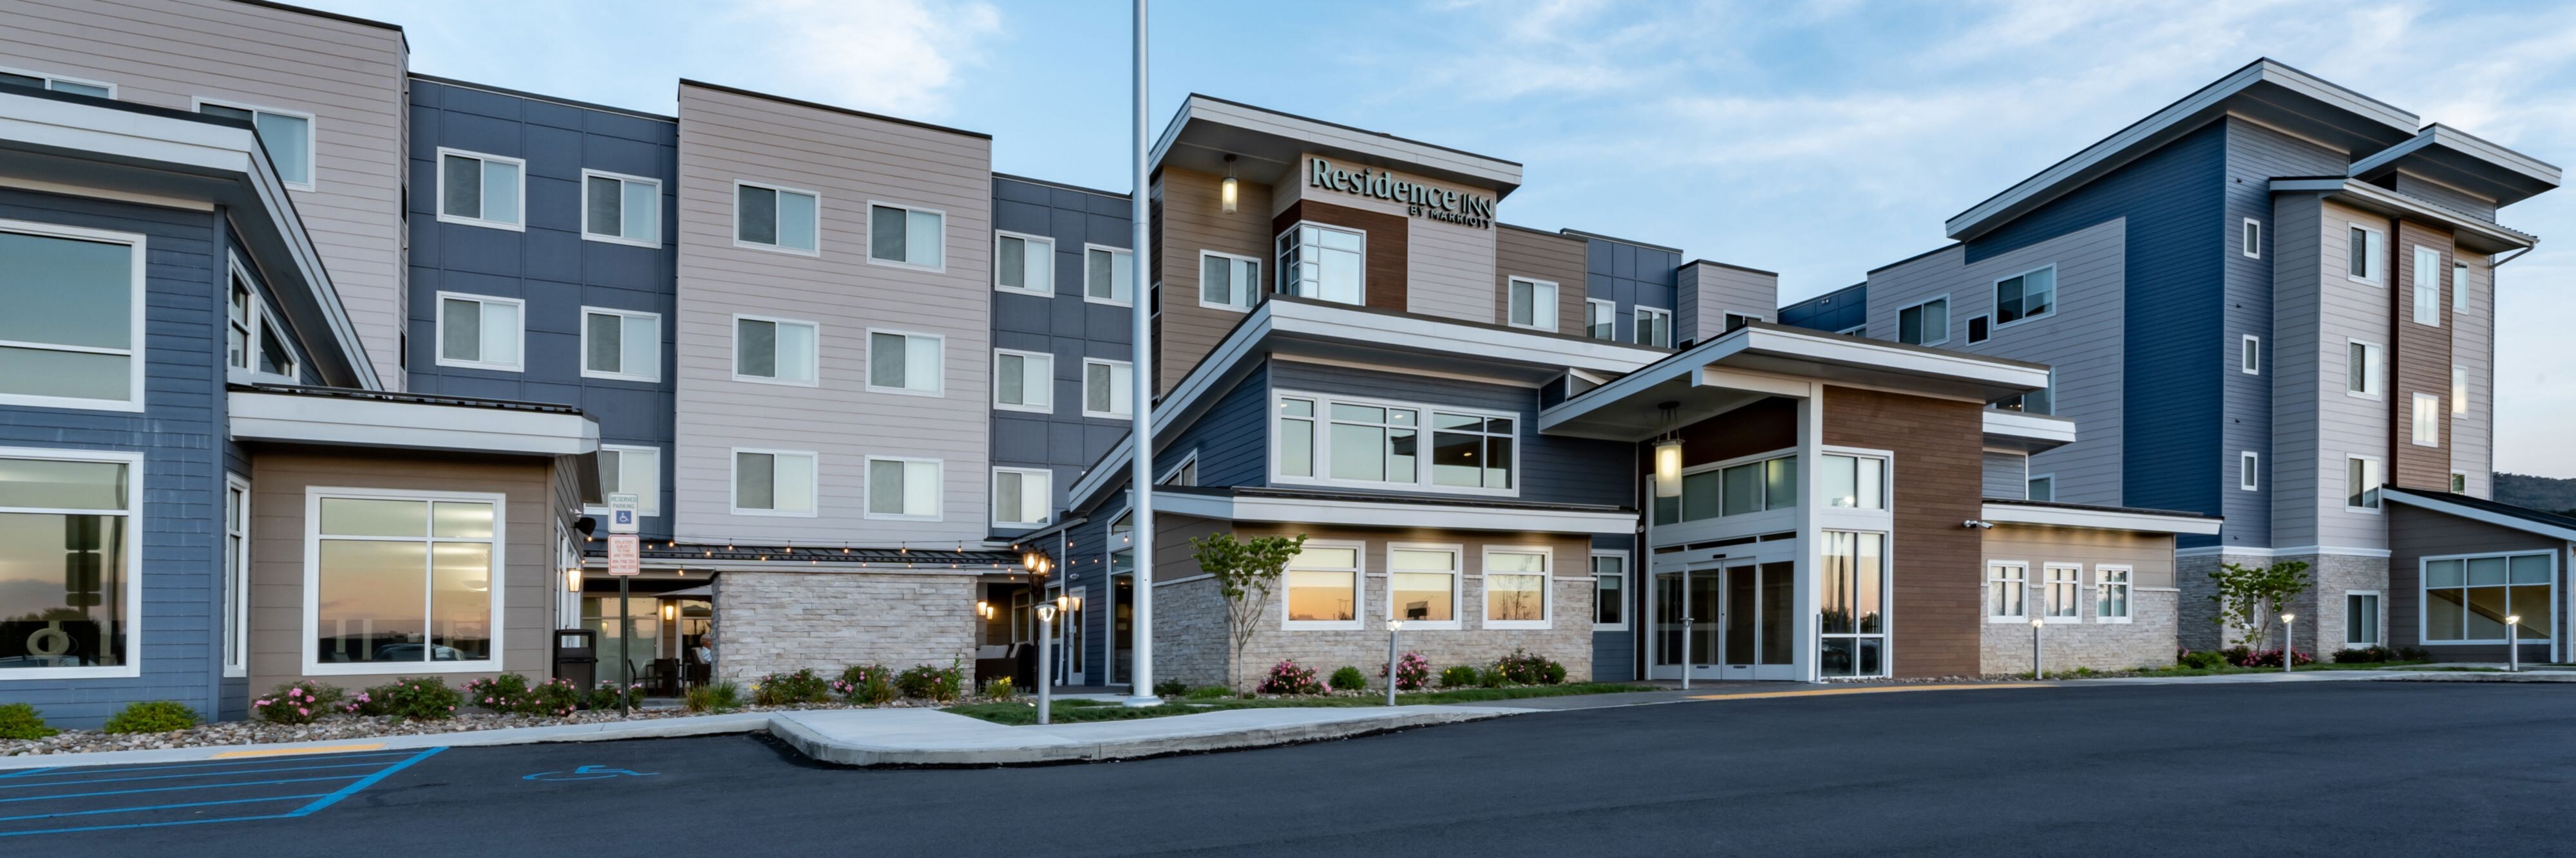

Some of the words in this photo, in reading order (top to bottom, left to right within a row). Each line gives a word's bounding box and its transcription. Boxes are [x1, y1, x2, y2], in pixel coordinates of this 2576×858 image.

[1311, 157, 1457, 210] Residence
[1461, 193, 1492, 219] INN
[1409, 205, 1425, 216] BY
[1429, 209, 1492, 228] MARRIOTT
